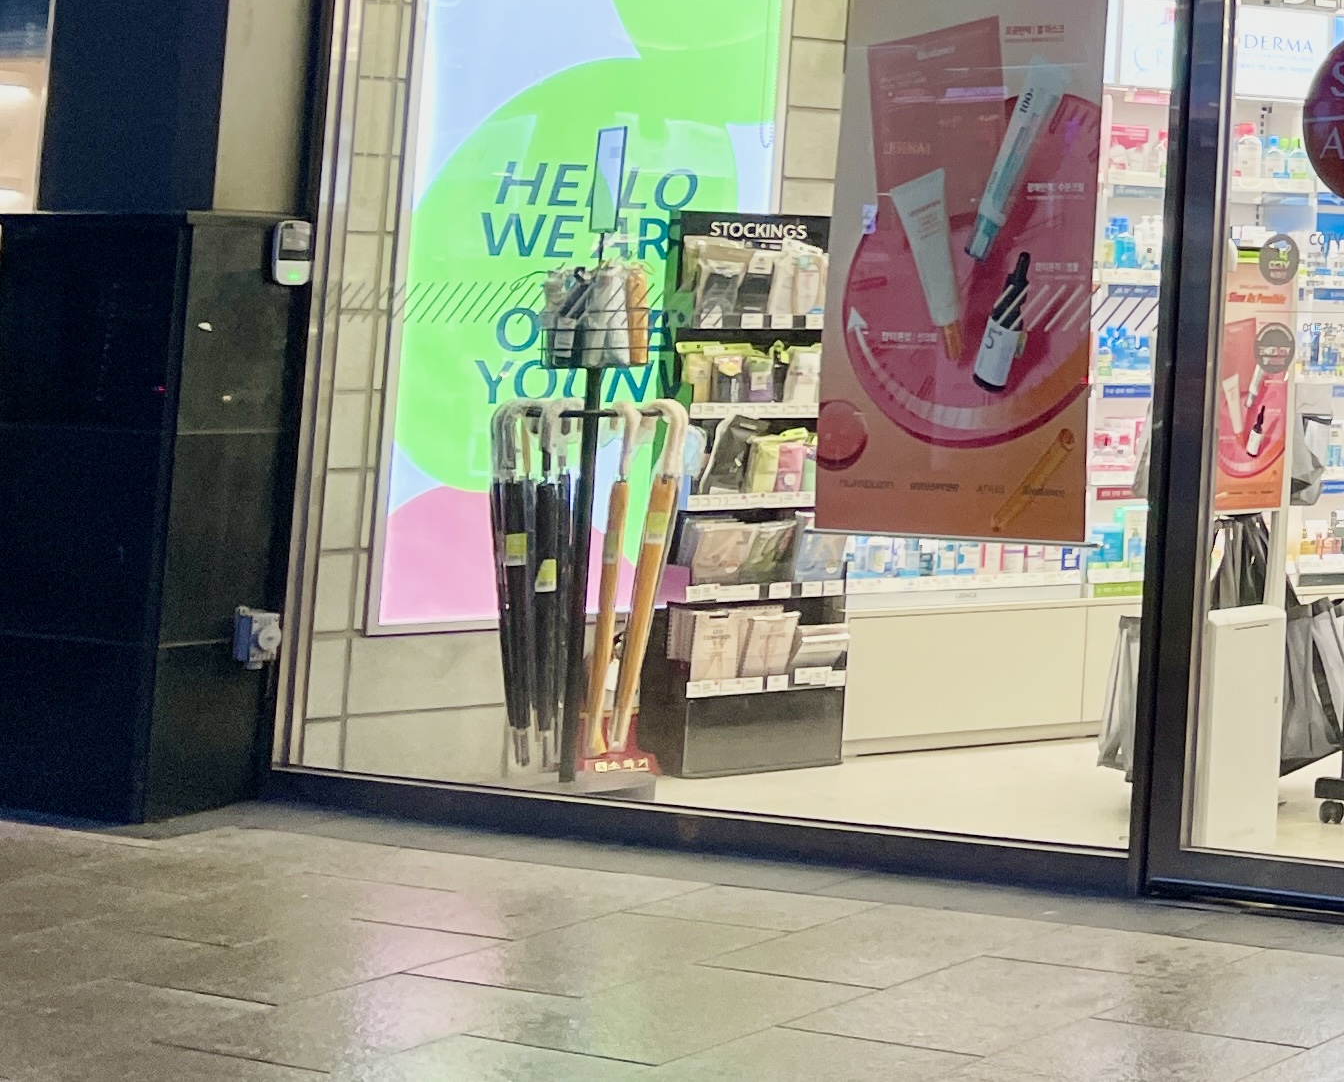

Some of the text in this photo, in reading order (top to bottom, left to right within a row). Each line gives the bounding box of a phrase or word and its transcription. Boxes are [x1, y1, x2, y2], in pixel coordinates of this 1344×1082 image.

[1243, 33, 1314, 54] DERMA
[495, 160, 699, 212] HELO
[480, 212, 583, 258] WE
[710, 221, 808, 241] STOCKINGS
